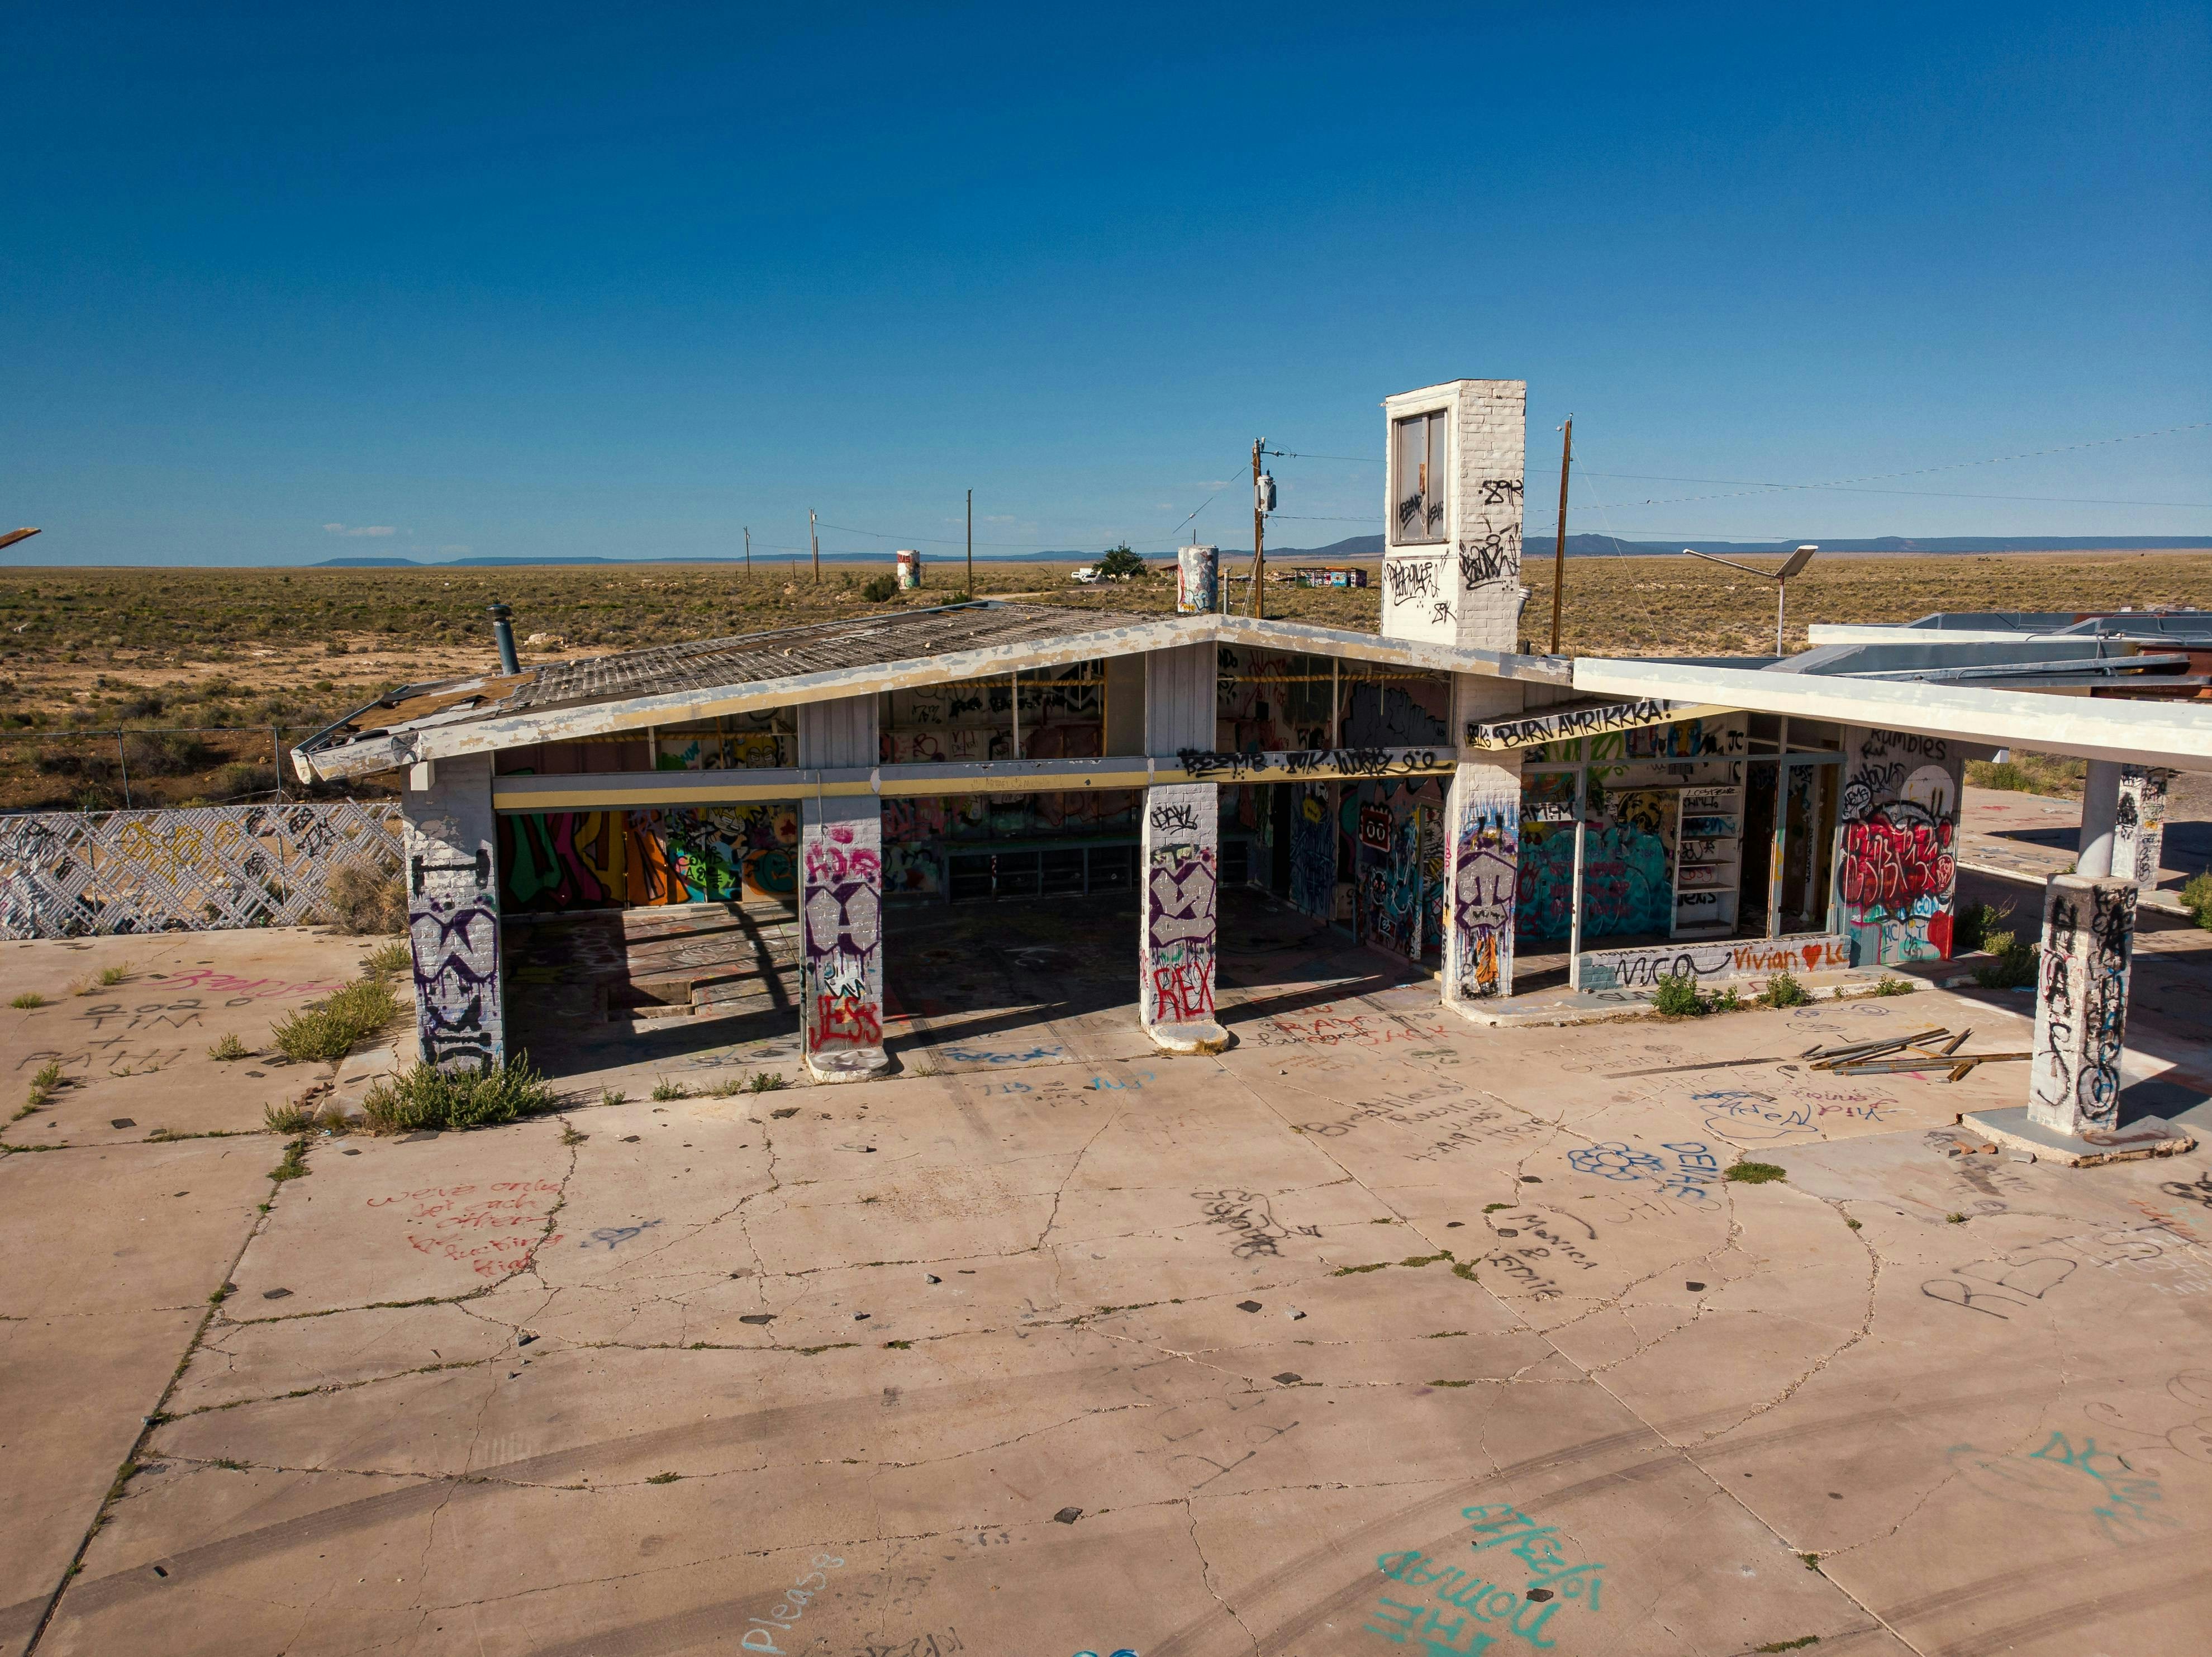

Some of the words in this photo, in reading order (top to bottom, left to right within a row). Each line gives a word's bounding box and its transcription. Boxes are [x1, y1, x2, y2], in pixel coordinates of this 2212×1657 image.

[1492, 718, 1554, 748] BURN
[1558, 699, 1672, 738] AMRIKKKA!
[1733, 945, 1798, 971] Vivian
[1304, 1083, 1464, 1137] Breathless
